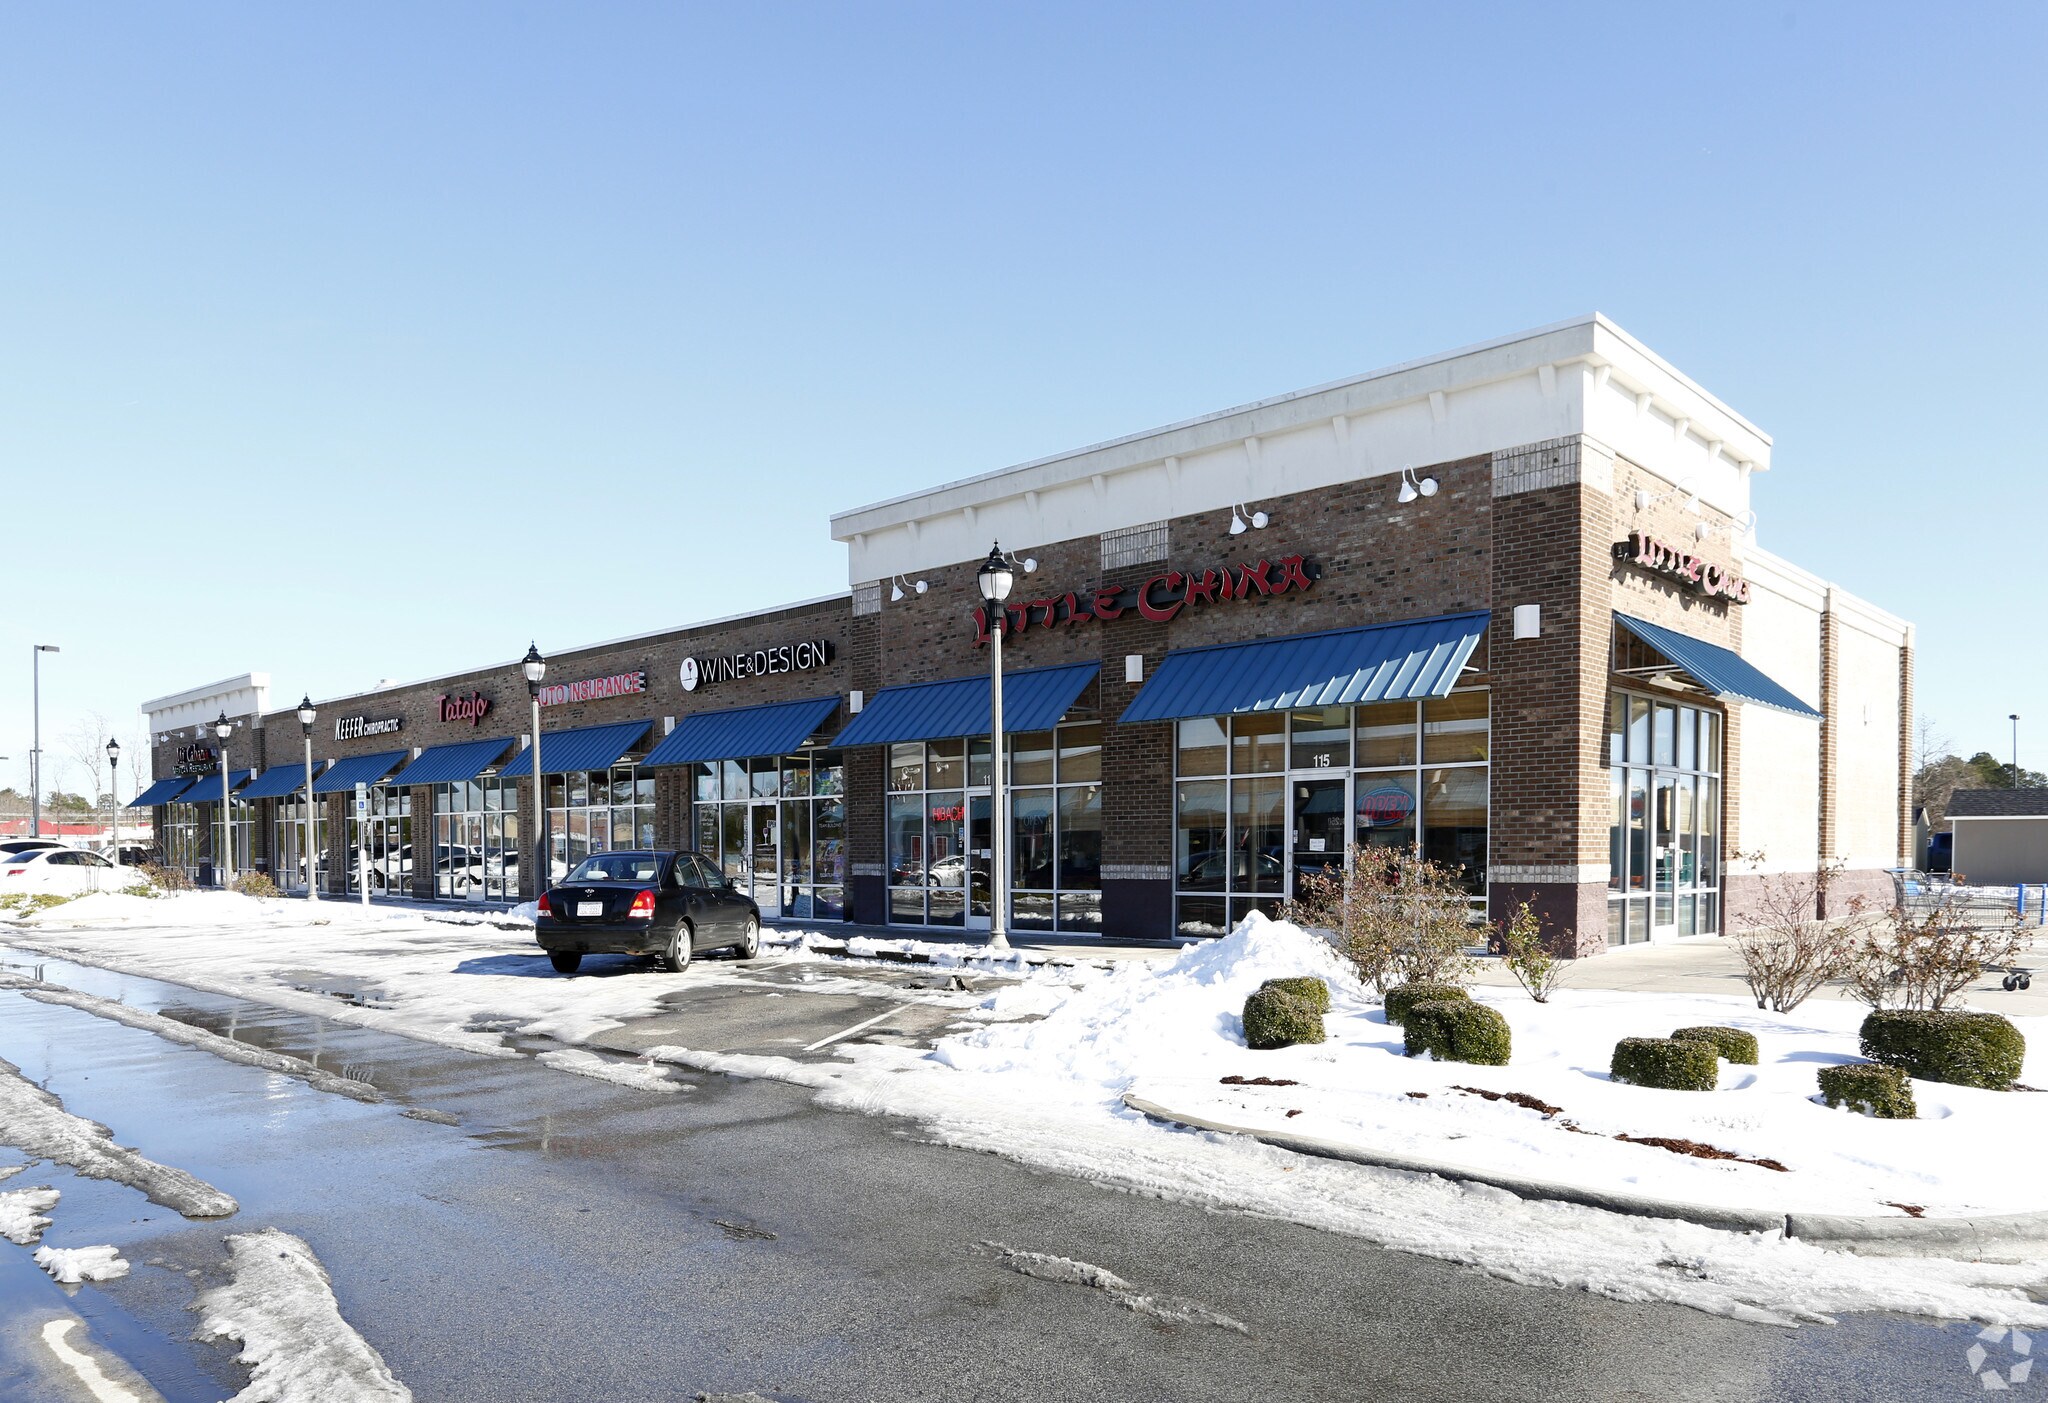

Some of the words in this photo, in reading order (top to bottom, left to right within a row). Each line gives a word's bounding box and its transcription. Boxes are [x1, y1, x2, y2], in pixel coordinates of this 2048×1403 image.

[1634, 529, 1702, 581] LITTLE
[1138, 554, 1313, 622] CHINA
[569, 672, 640, 702] INSURANCE
[433, 690, 488, 728] Tatajo
[335, 716, 364, 740] KEEFER
[364, 718, 399, 736] CHIROPRACTIC
[1313, 754, 1330, 767] 115
[983, 774, 991, 785] 11
[1361, 795, 1409, 819] OPEN
